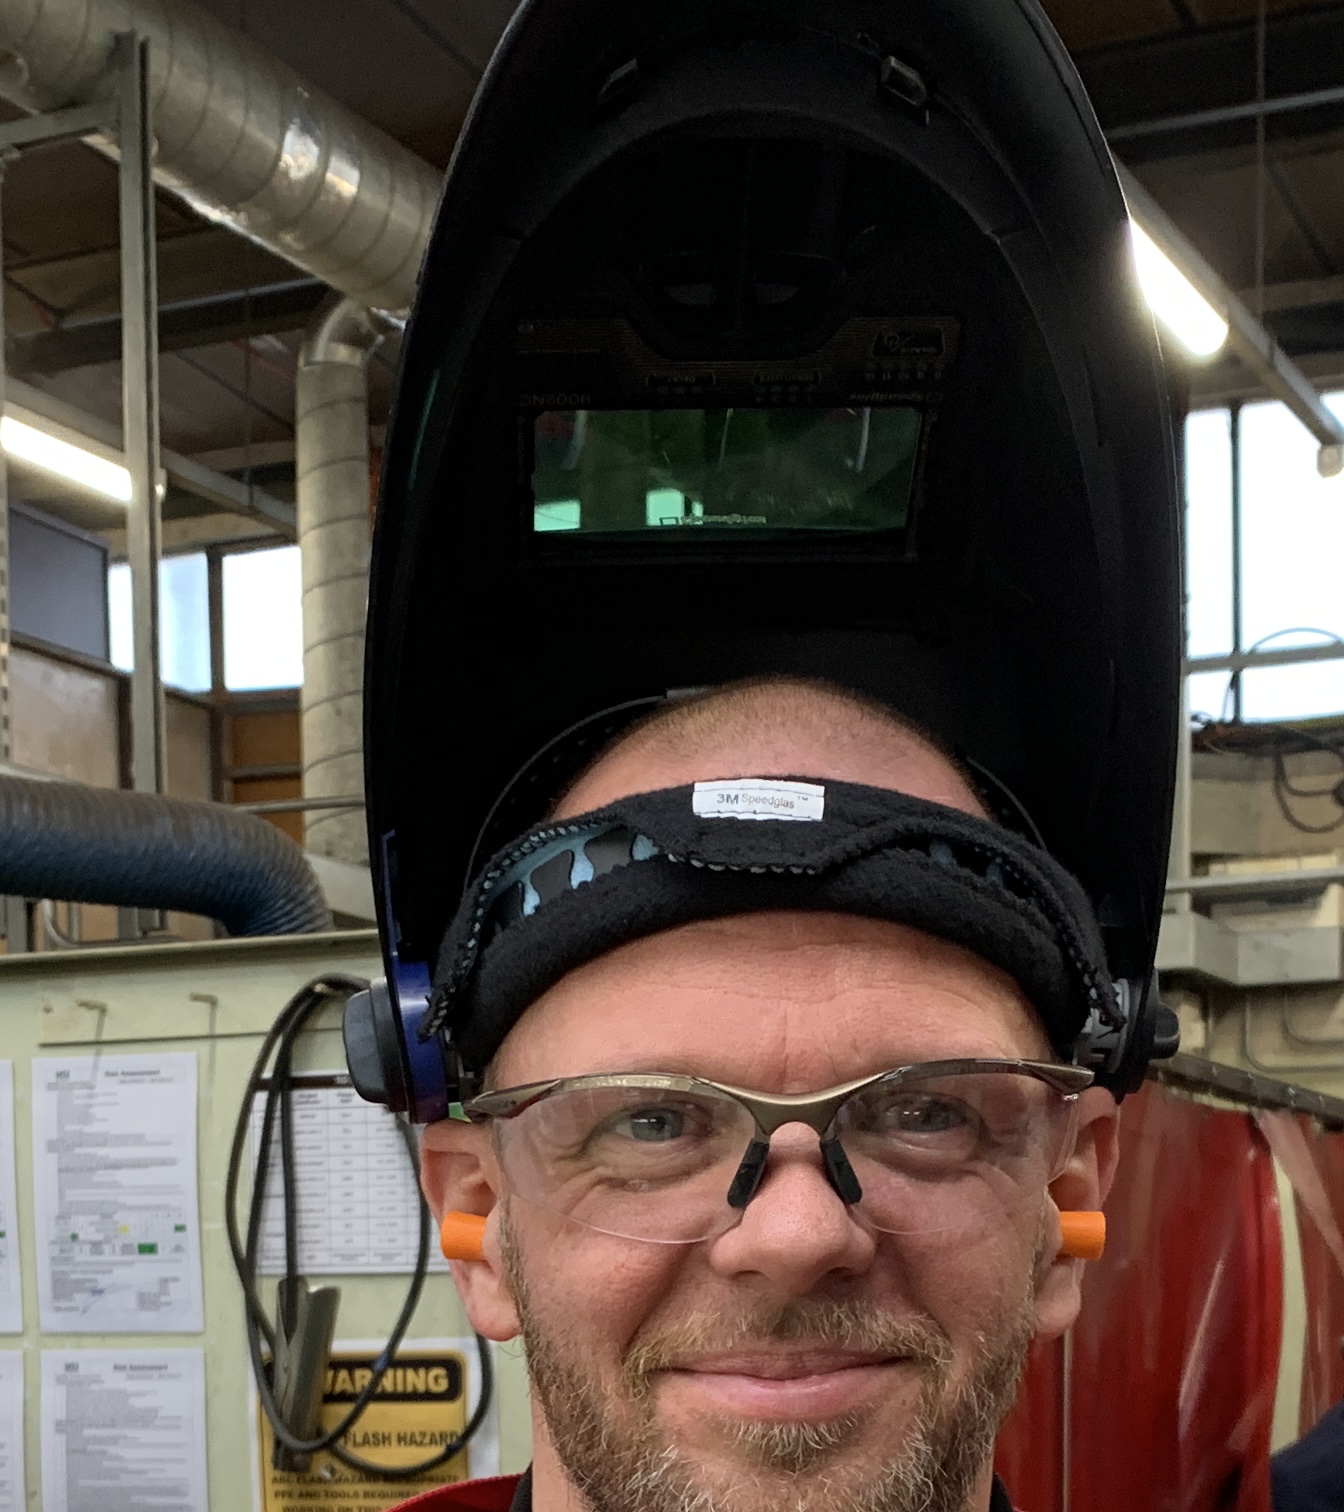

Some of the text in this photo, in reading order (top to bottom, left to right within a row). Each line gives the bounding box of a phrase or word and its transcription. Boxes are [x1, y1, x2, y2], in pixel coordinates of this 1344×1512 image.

[716, 792, 795, 810] 3M Speedglas
[325, 1366, 450, 1394] ARNING
